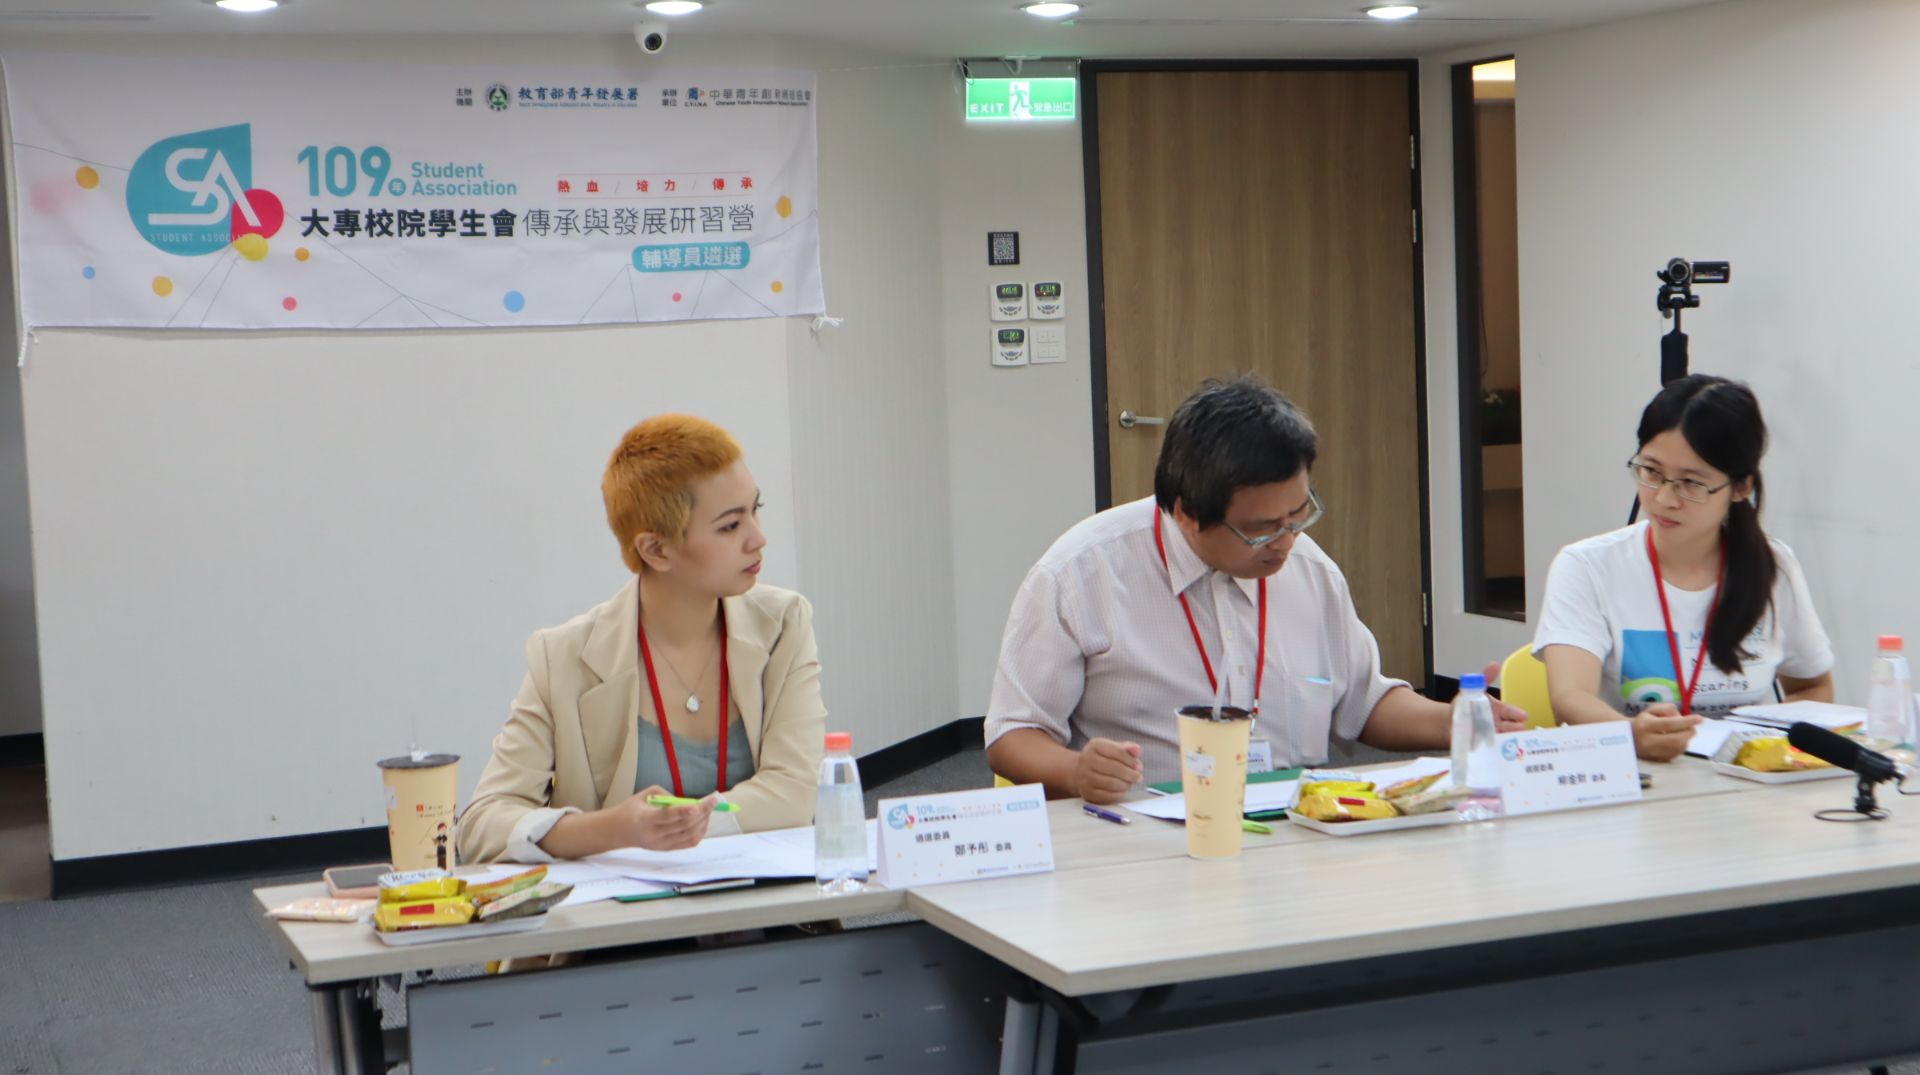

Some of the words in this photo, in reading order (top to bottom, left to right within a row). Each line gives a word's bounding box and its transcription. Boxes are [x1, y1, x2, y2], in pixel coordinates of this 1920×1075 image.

[518, 87, 638, 101] 教育部青年發展署
[970, 103, 1004, 113] EXIT
[1033, 101, 1072, 113] 緊急出口
[411, 161, 484, 178] Student
[411, 180, 518, 196] Association
[150, 232, 194, 243] STUDENT
[641, 245, 743, 269] 輔導員遴選
